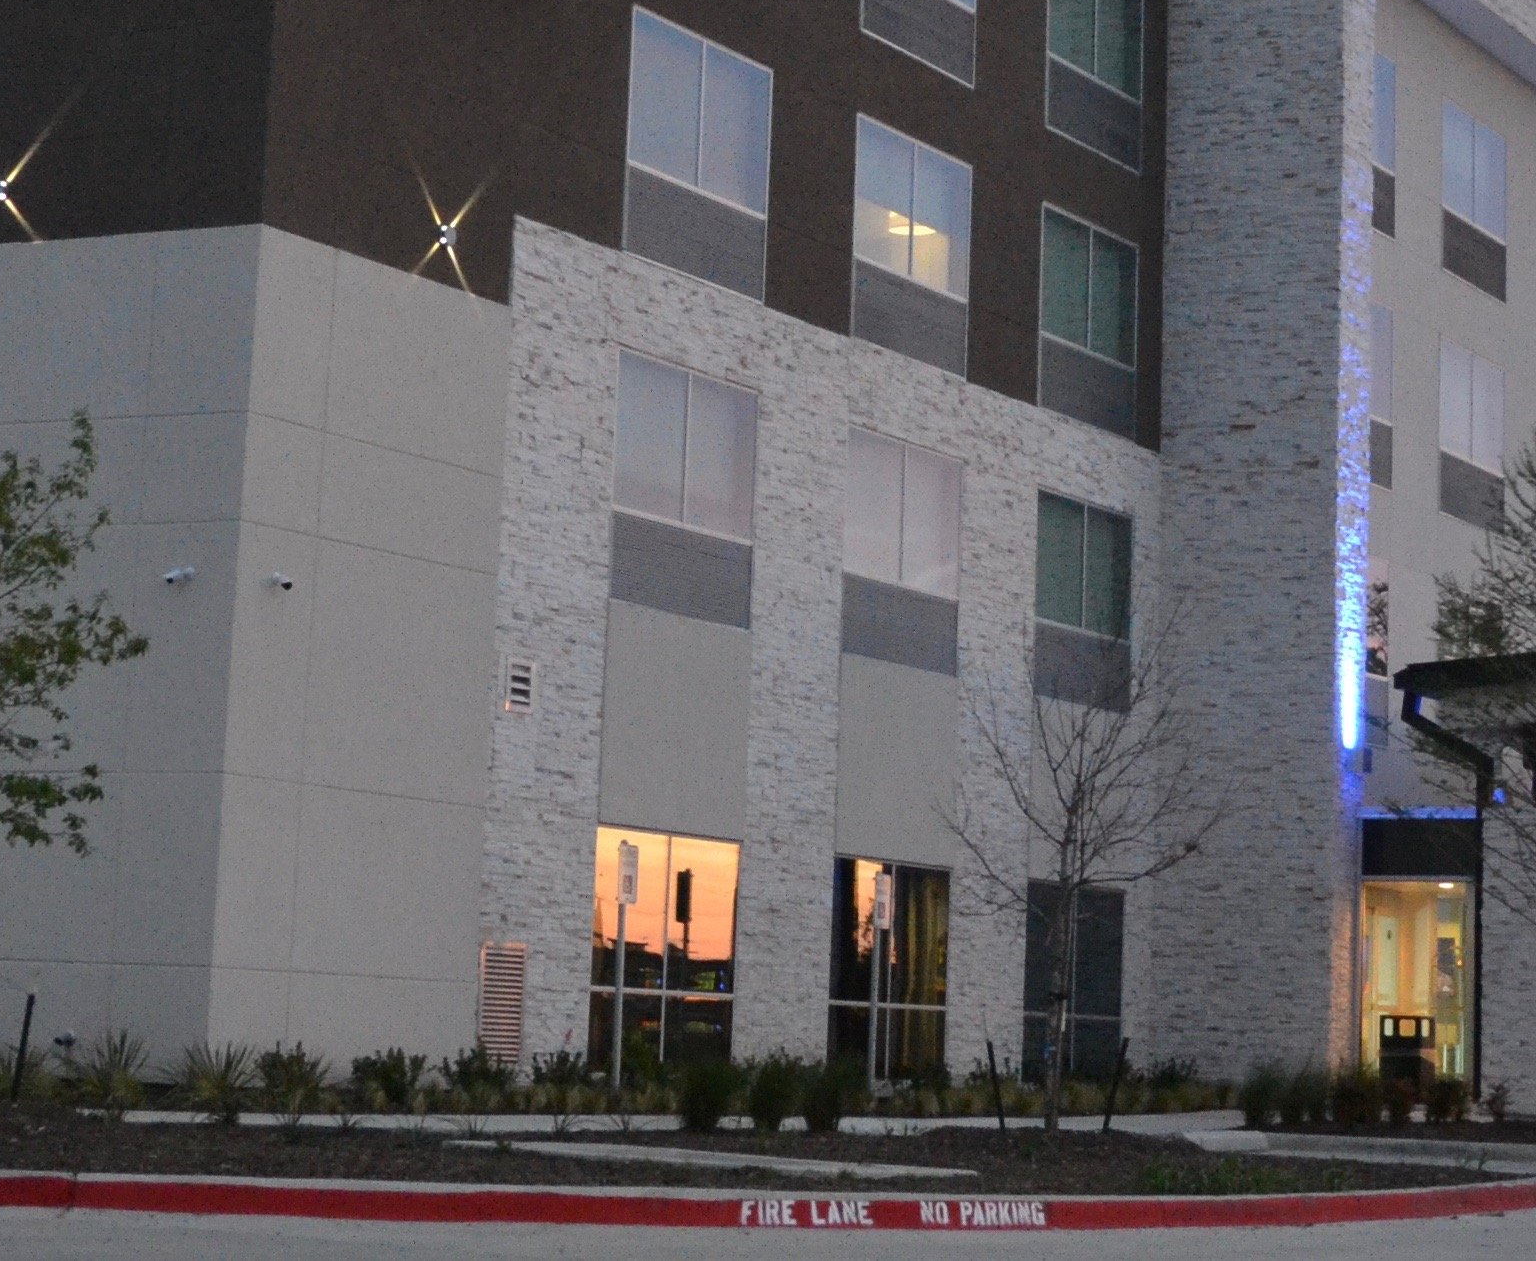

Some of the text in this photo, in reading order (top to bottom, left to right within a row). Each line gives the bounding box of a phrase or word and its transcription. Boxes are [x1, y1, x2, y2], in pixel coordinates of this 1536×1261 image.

[740, 1200, 1046, 1227] FIRE LANE NO PARKING
